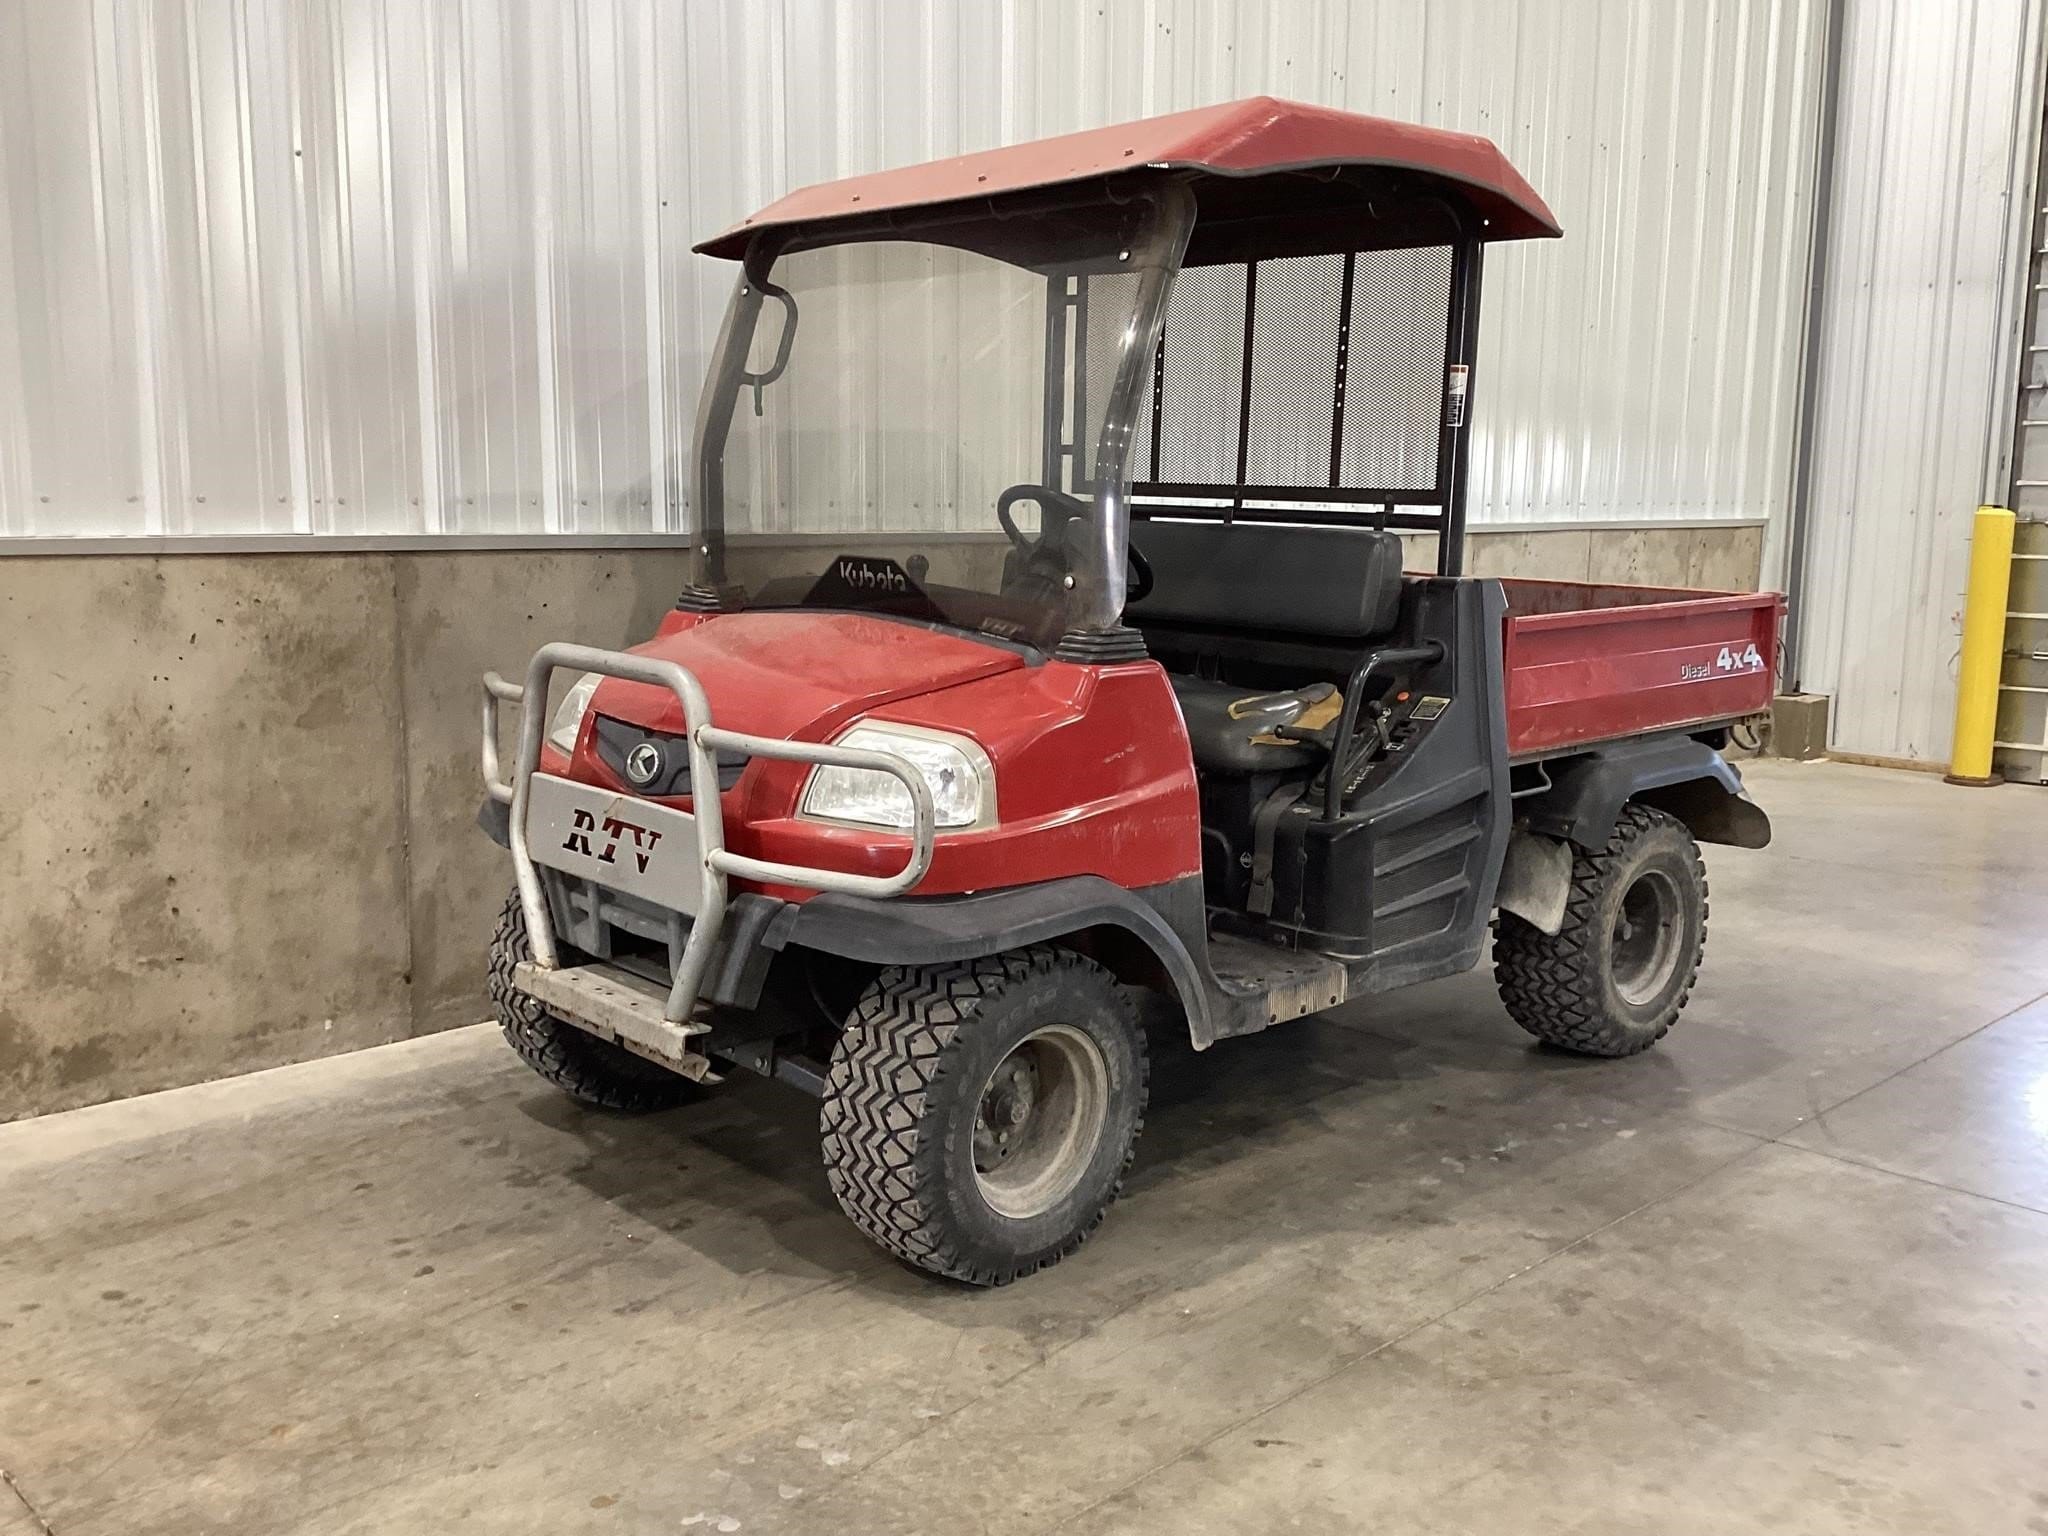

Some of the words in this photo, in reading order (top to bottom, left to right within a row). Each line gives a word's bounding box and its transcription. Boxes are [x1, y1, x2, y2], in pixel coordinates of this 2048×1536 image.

[840, 561, 906, 592] Kubota
[1681, 660, 1711, 680] Diesel
[1716, 643, 1757, 671] 4x4
[562, 808, 662, 874] RTV
